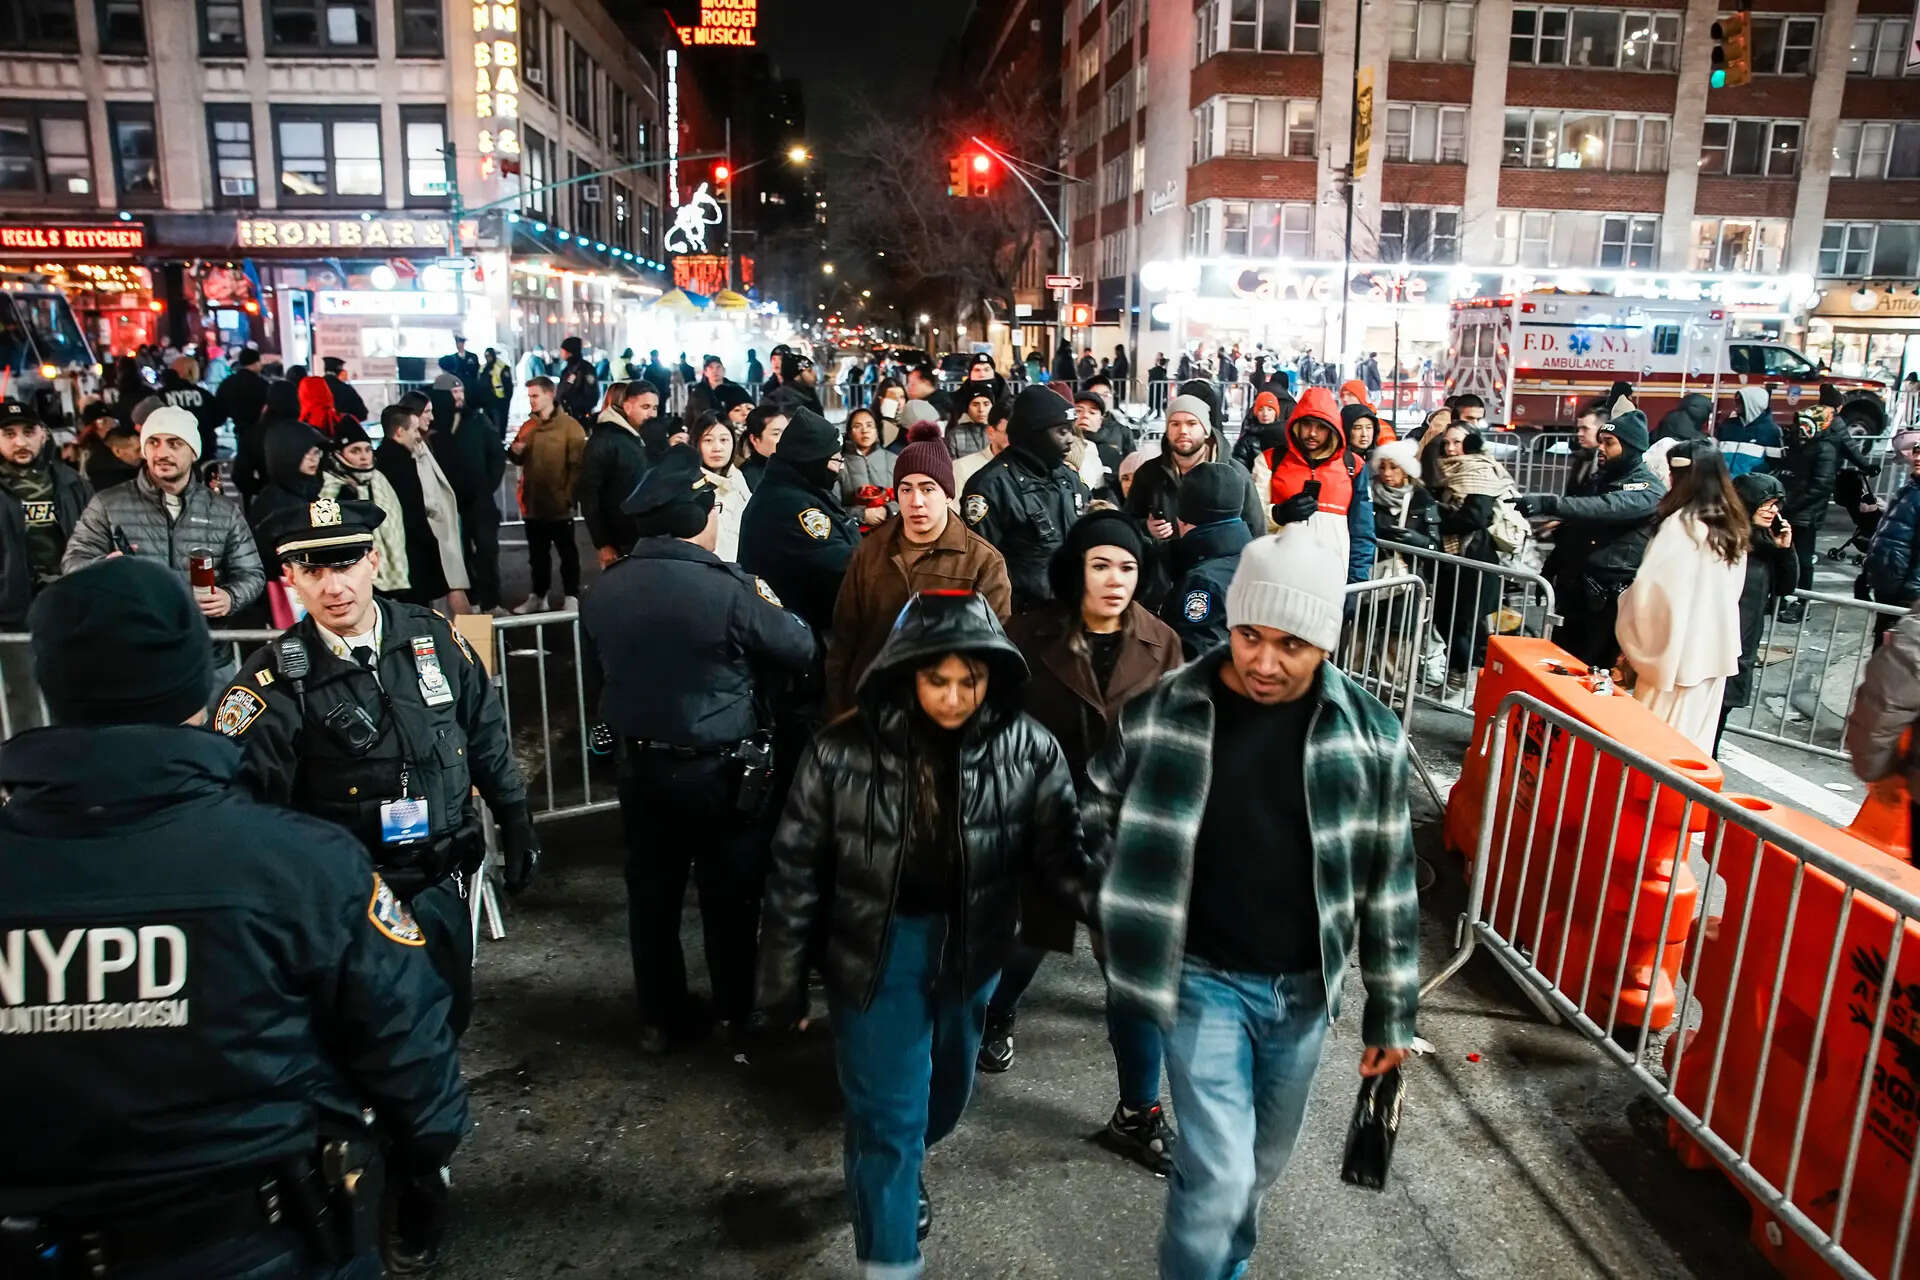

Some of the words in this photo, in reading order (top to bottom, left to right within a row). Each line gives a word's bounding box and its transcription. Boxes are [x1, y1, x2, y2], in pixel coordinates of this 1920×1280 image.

[694, 27, 756, 45] MUSICAL
[494, 40, 519, 118] BAR
[63, 229, 143, 248] KITCHEN
[240, 221, 331, 246] IRON
[339, 221, 416, 246] BAR
[422, 222, 446, 245] &
[1876, 294, 1920, 311] Amo
[1523, 333, 1559, 351] F.D.
[1600, 335, 1636, 353] N.Y.
[1542, 357, 1616, 370] AMBULANCE
[165, 389, 203, 407] NYPD
[0, 925, 188, 1006] NYPD
